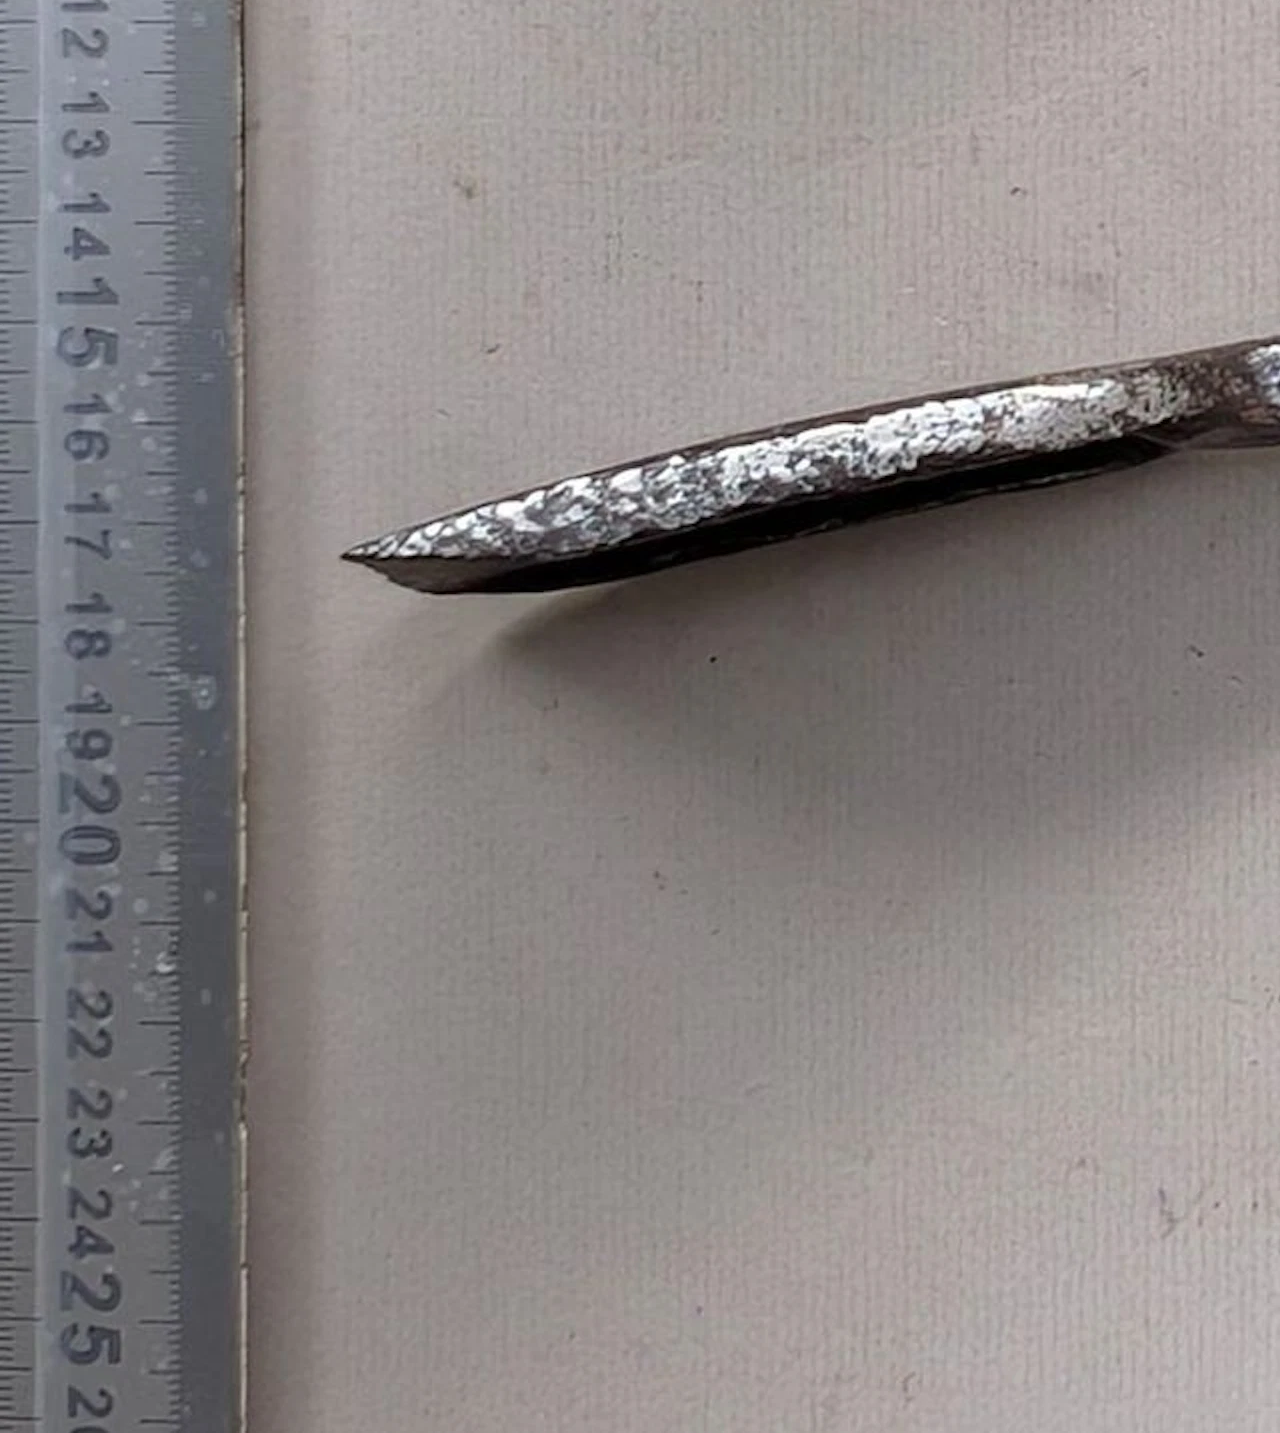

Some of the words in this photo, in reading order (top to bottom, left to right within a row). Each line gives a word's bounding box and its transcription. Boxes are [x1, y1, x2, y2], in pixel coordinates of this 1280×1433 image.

[61, 91, 110, 159] 13
[62, 192, 111, 260] 14
[56, 277, 120, 366] 15
[63, 393, 110, 461] 16
[64, 492, 112, 560] 17
[64, 592, 113, 660] 18
[64, 692, 113, 760] 19
[57, 773, 121, 866] 20
[65, 891, 113, 953] 21
[66, 991, 113, 1058] 22
[66, 1089, 113, 1159] 23
[67, 1189, 115, 1261] 24
[59, 1270, 122, 1366] 25
[68, 1384, 113, 1433] 2
